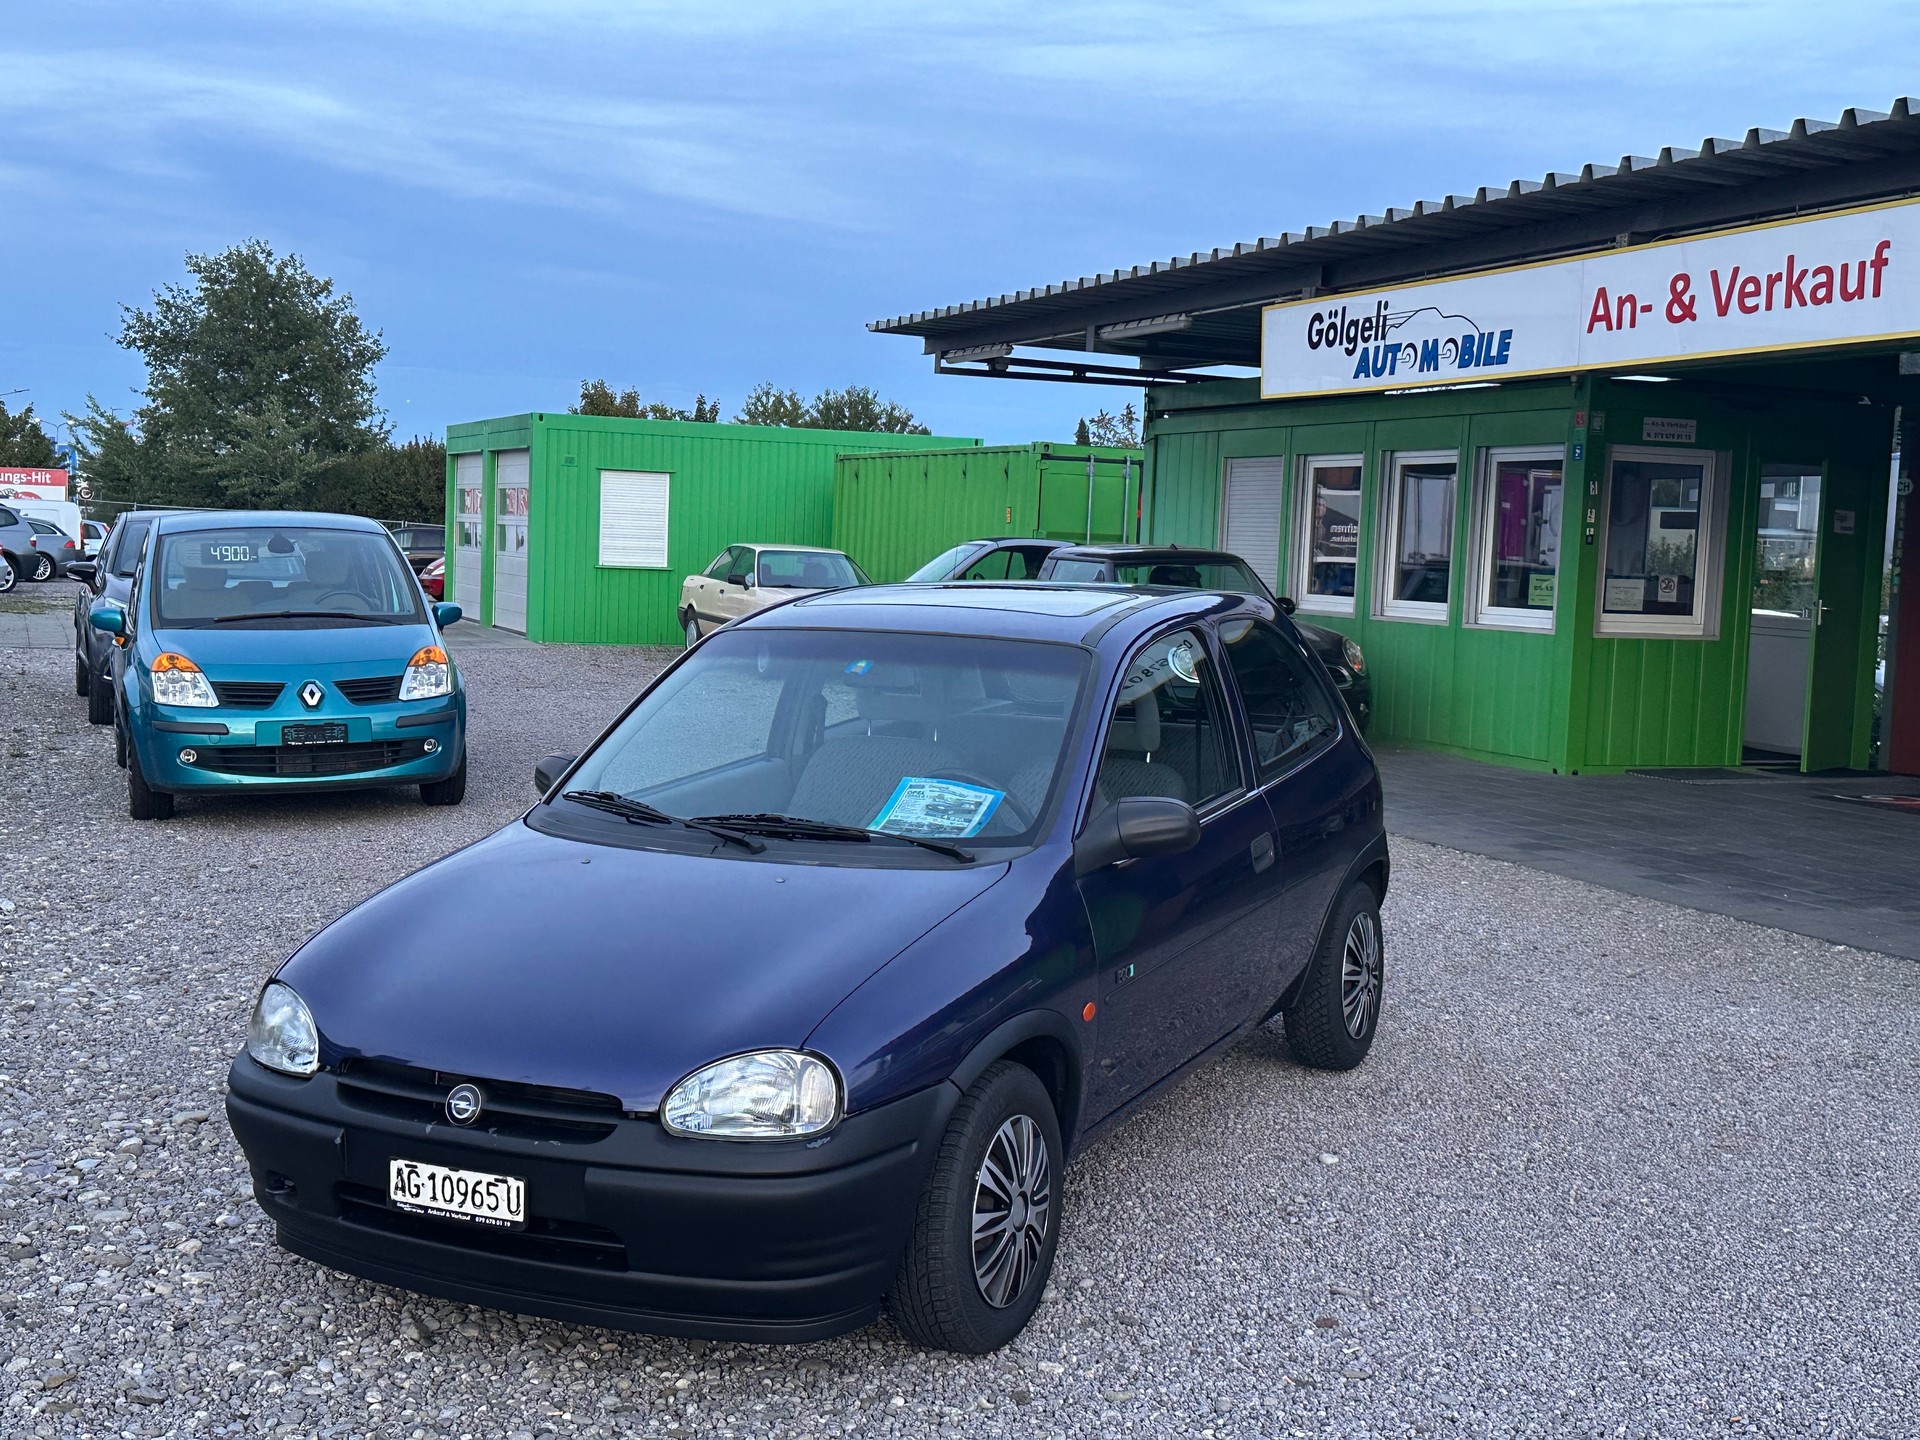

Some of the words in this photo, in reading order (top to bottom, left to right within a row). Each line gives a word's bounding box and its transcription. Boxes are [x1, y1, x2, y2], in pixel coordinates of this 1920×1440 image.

[1586, 286, 1653, 334] An-
[1665, 272, 1697, 324] &
[1709, 239, 1891, 317] Verkauf
[1307, 300, 1389, 357] Gölgeli
